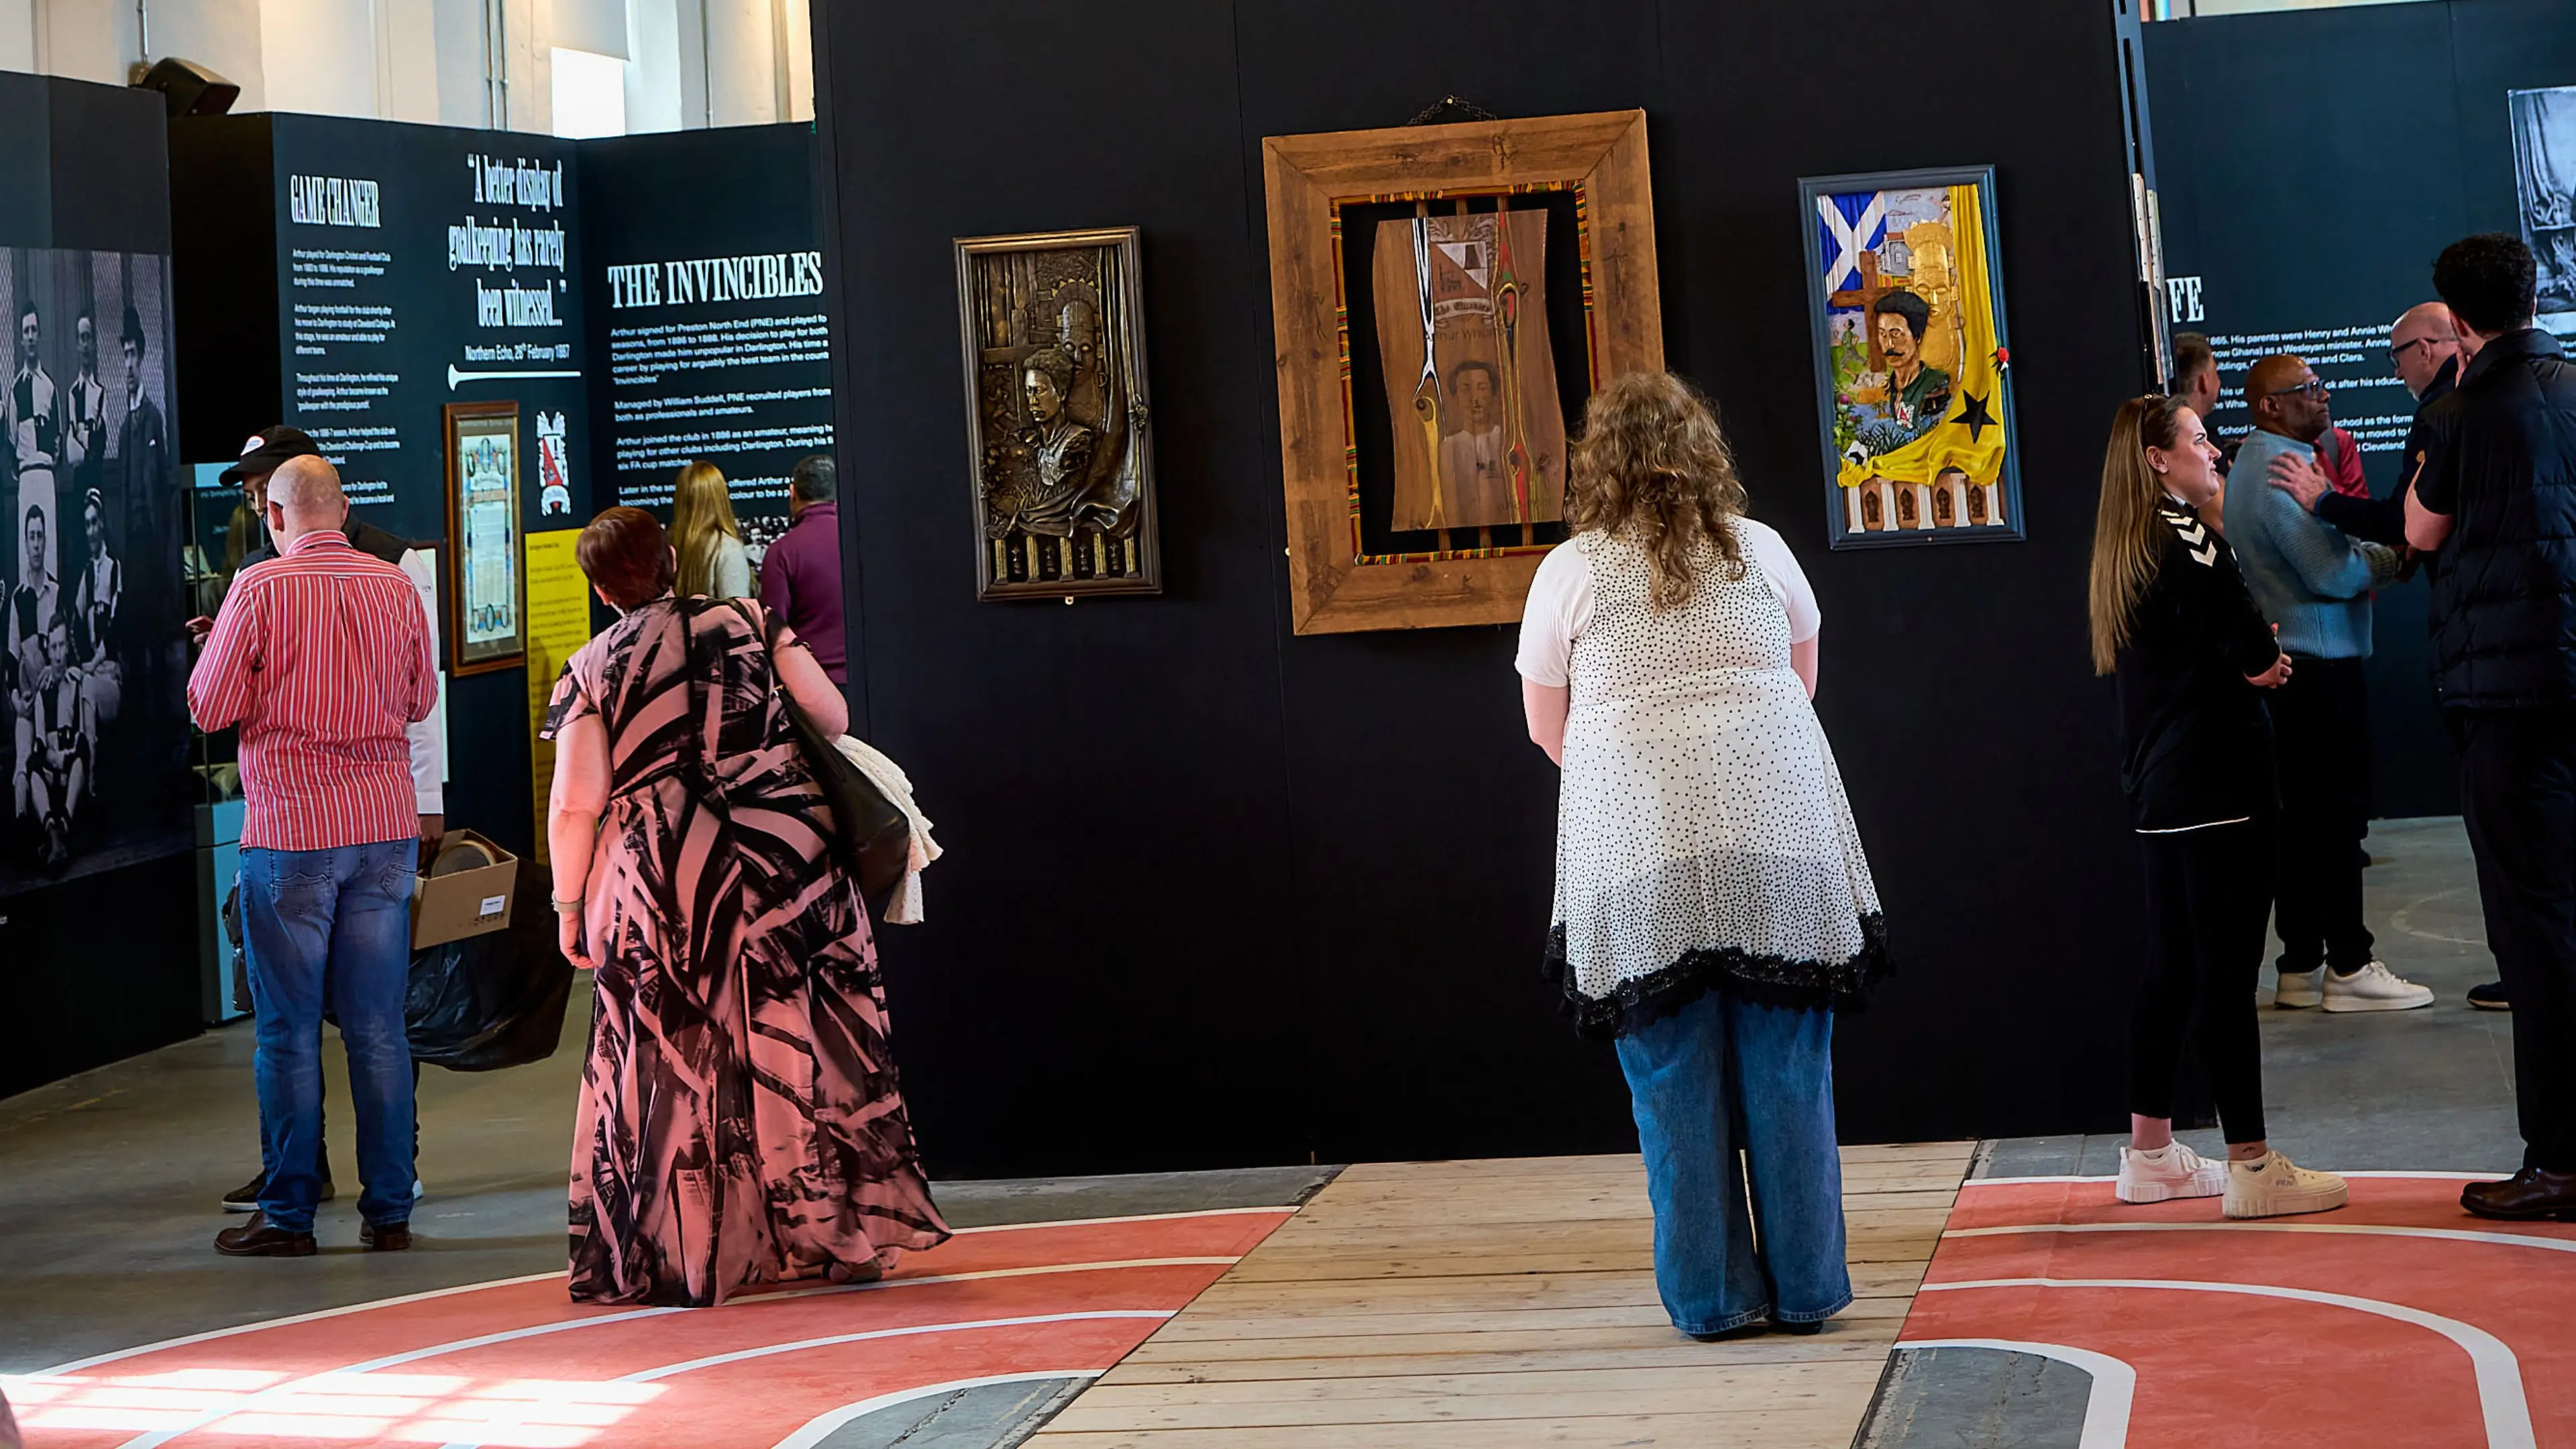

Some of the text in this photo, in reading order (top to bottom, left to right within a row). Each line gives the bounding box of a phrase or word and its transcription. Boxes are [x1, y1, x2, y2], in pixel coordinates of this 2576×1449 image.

[484, 154, 515, 205] better
[516, 157, 551, 213] display
[552, 159, 563, 207] of
[290, 174, 381, 228] GAME CHANGER
[448, 215, 565, 272] goalkeeping has rarely
[607, 251, 824, 308] THE INVINCIBLES
[476, 278, 504, 327] been
[2165, 276, 2204, 323] FE
[2231, 334, 2246, 344] His
[2247, 333, 2280, 344] parents
[2281, 331, 2303, 341] were
[2304, 328, 2332, 340] Henry
[2332, 327, 2349, 337] and
[2351, 325, 2377, 336] Annie
[465, 345, 496, 362] Northern
[496, 343, 515, 362] Echo,
[527, 344, 555, 362] February
[2264, 347, 2275, 356] as
[2326, 339, 2364, 351] minister.
[2365, 337, 2392, 348] Annie
[2321, 355, 2339, 364] and
[2339, 353, 2365, 363] Clara.
[2220, 387, 2234, 397] his
[2338, 378, 2359, 389] after
[2360, 377, 2374, 388] his
[2217, 424, 2249, 436] School
[2333, 416, 2363, 428] school
[2364, 417, 2376, 427] as
[2376, 415, 2392, 425] the
[2366, 427, 2397, 439] moved
[2397, 427, 2407, 437] to
[2361, 440, 2406, 452] Cleveland
